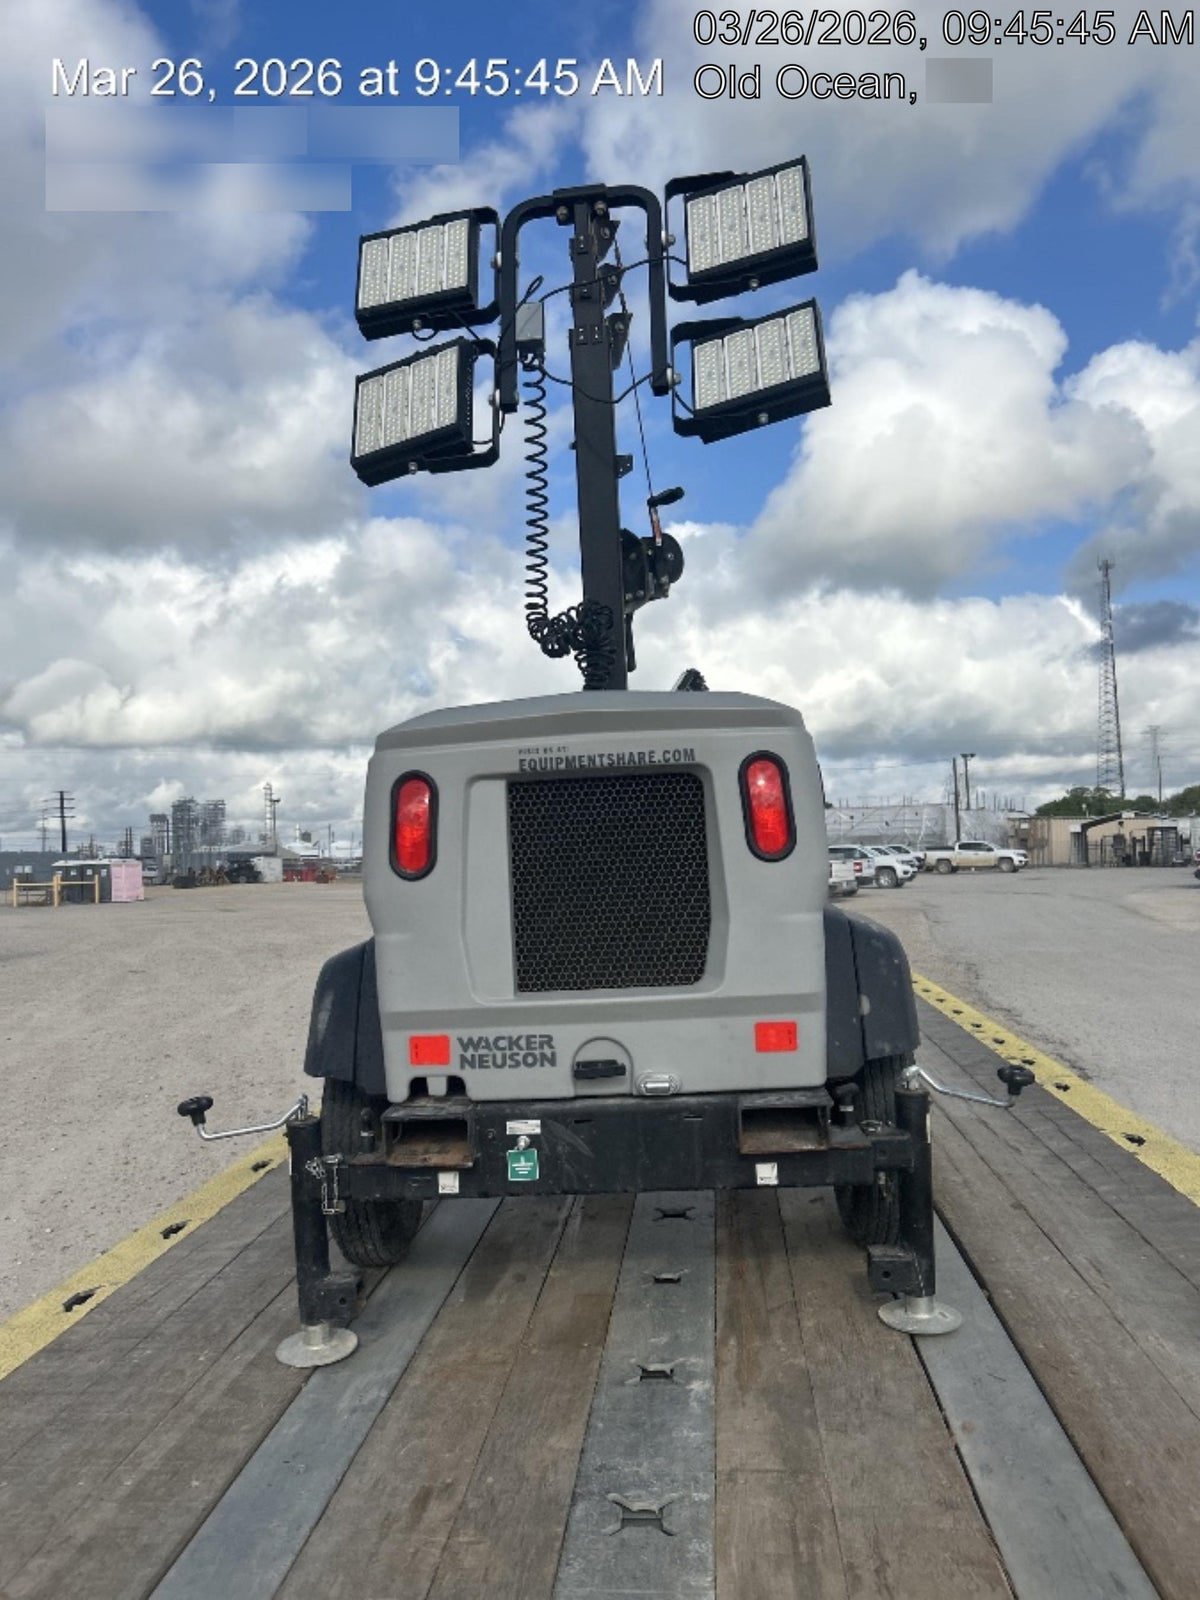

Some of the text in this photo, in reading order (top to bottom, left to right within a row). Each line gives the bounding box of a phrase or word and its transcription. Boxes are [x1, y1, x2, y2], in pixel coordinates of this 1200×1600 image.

[519, 748, 696, 772] EQUIPMENTSHARE.COM
[457, 1034, 555, 1053] WACKER
[459, 1051, 557, 1070] NEUSON
